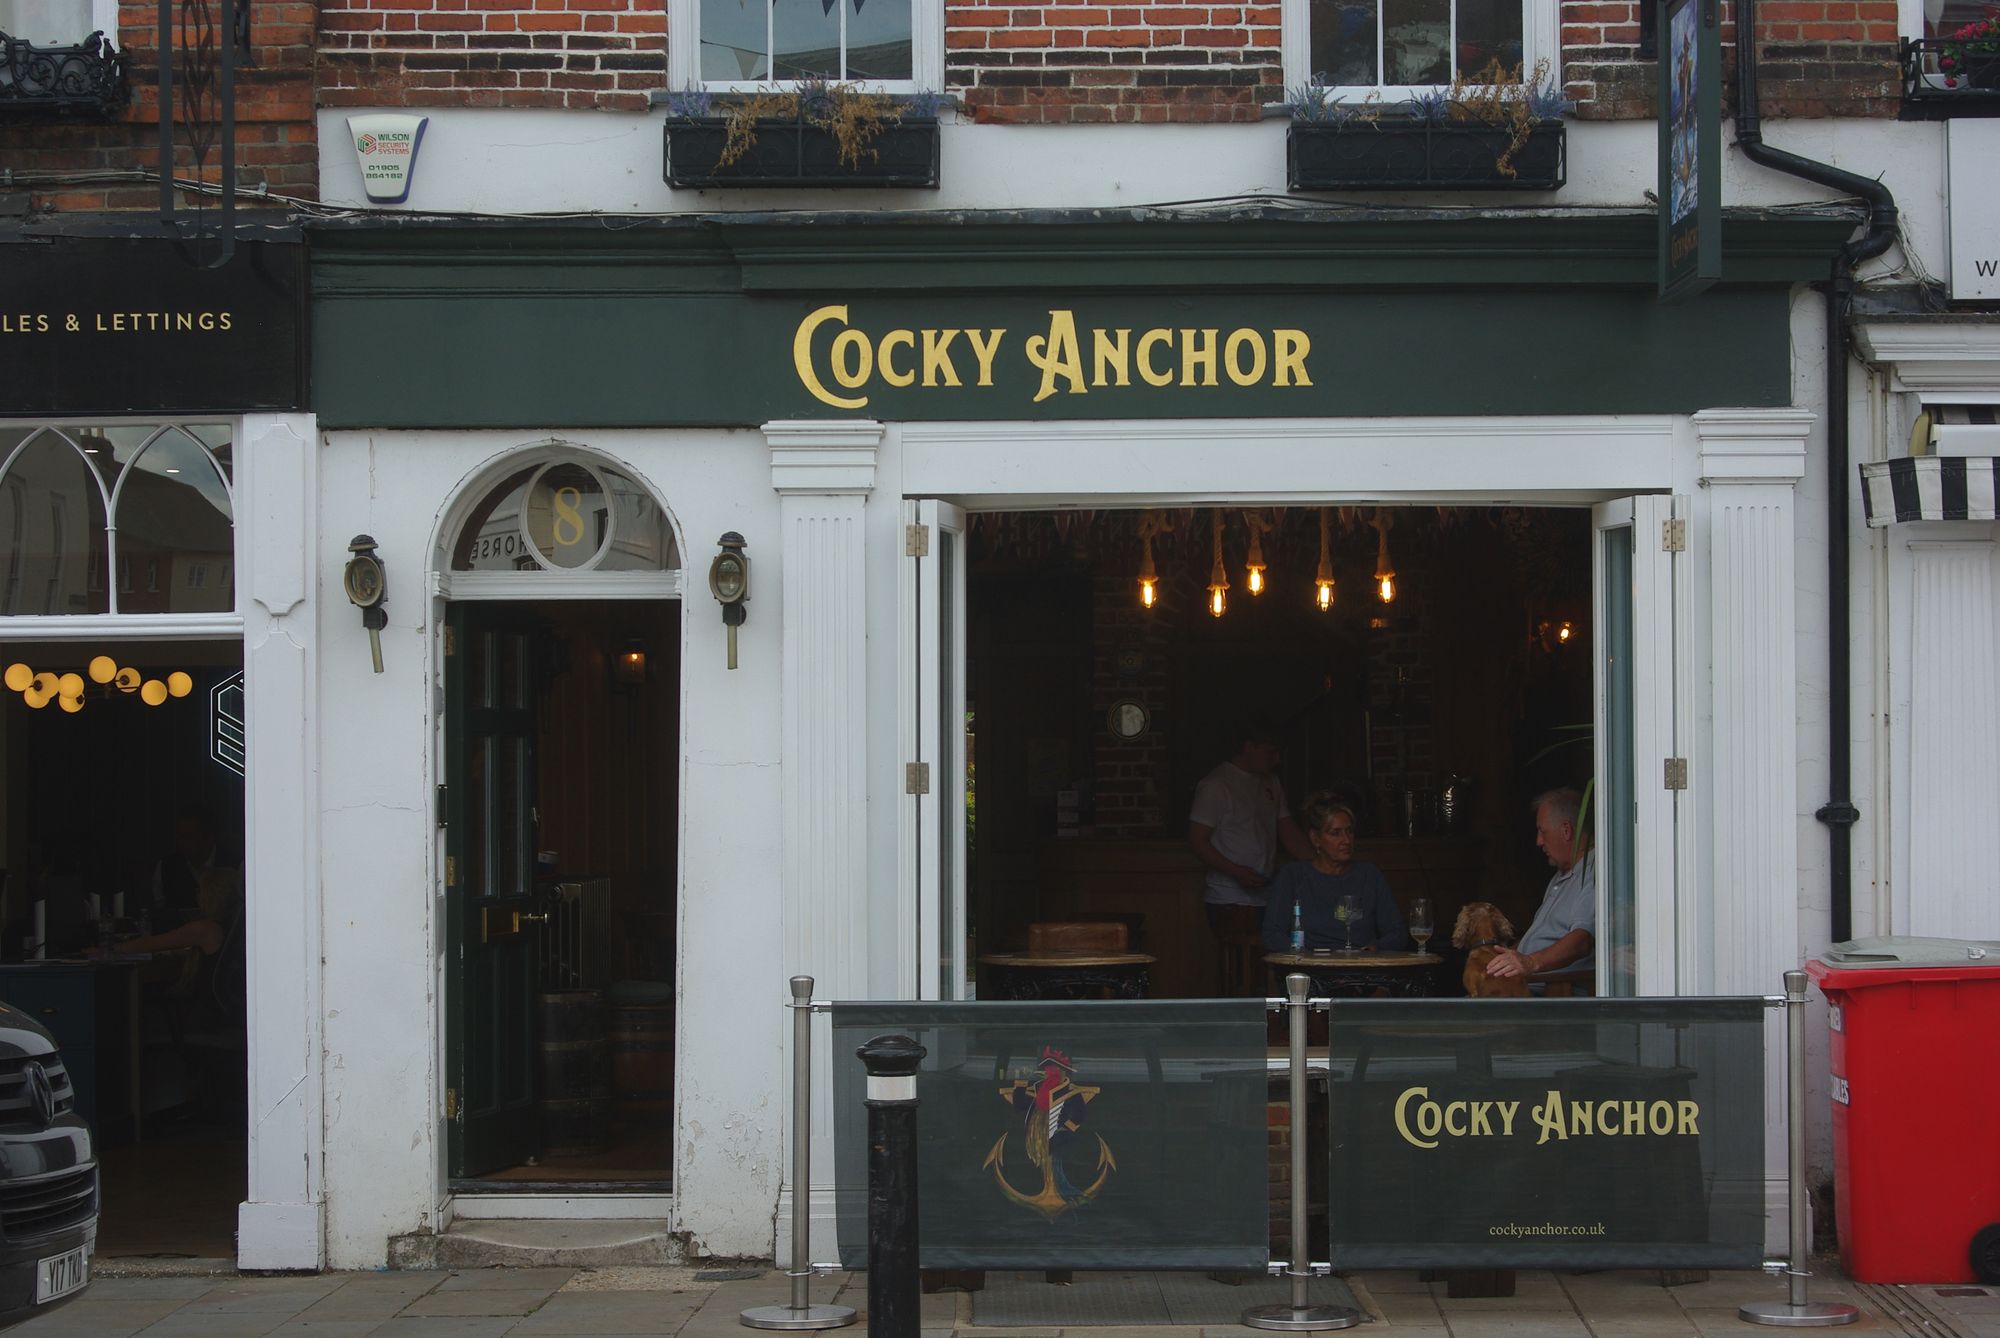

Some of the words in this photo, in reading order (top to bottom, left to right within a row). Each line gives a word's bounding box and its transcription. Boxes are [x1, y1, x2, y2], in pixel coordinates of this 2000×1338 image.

[378, 133, 410, 141] WILSON
[1975, 260, 1998, 277] W
[2, 314, 49, 333] LES
[65, 313, 80, 332] &
[96, 312, 232, 331] LETTINGS
[793, 304, 1007, 409] COCKY
[1025, 309, 1314, 402] ANCHOR
[553, 486, 585, 546] 8
[1394, 1086, 1520, 1149] COCKY
[1531, 1090, 1700, 1145] ANCHOR
[1489, 1222, 1606, 1239] cockyanchor.co.uk
[49, 1257, 66, 1294] Y17
